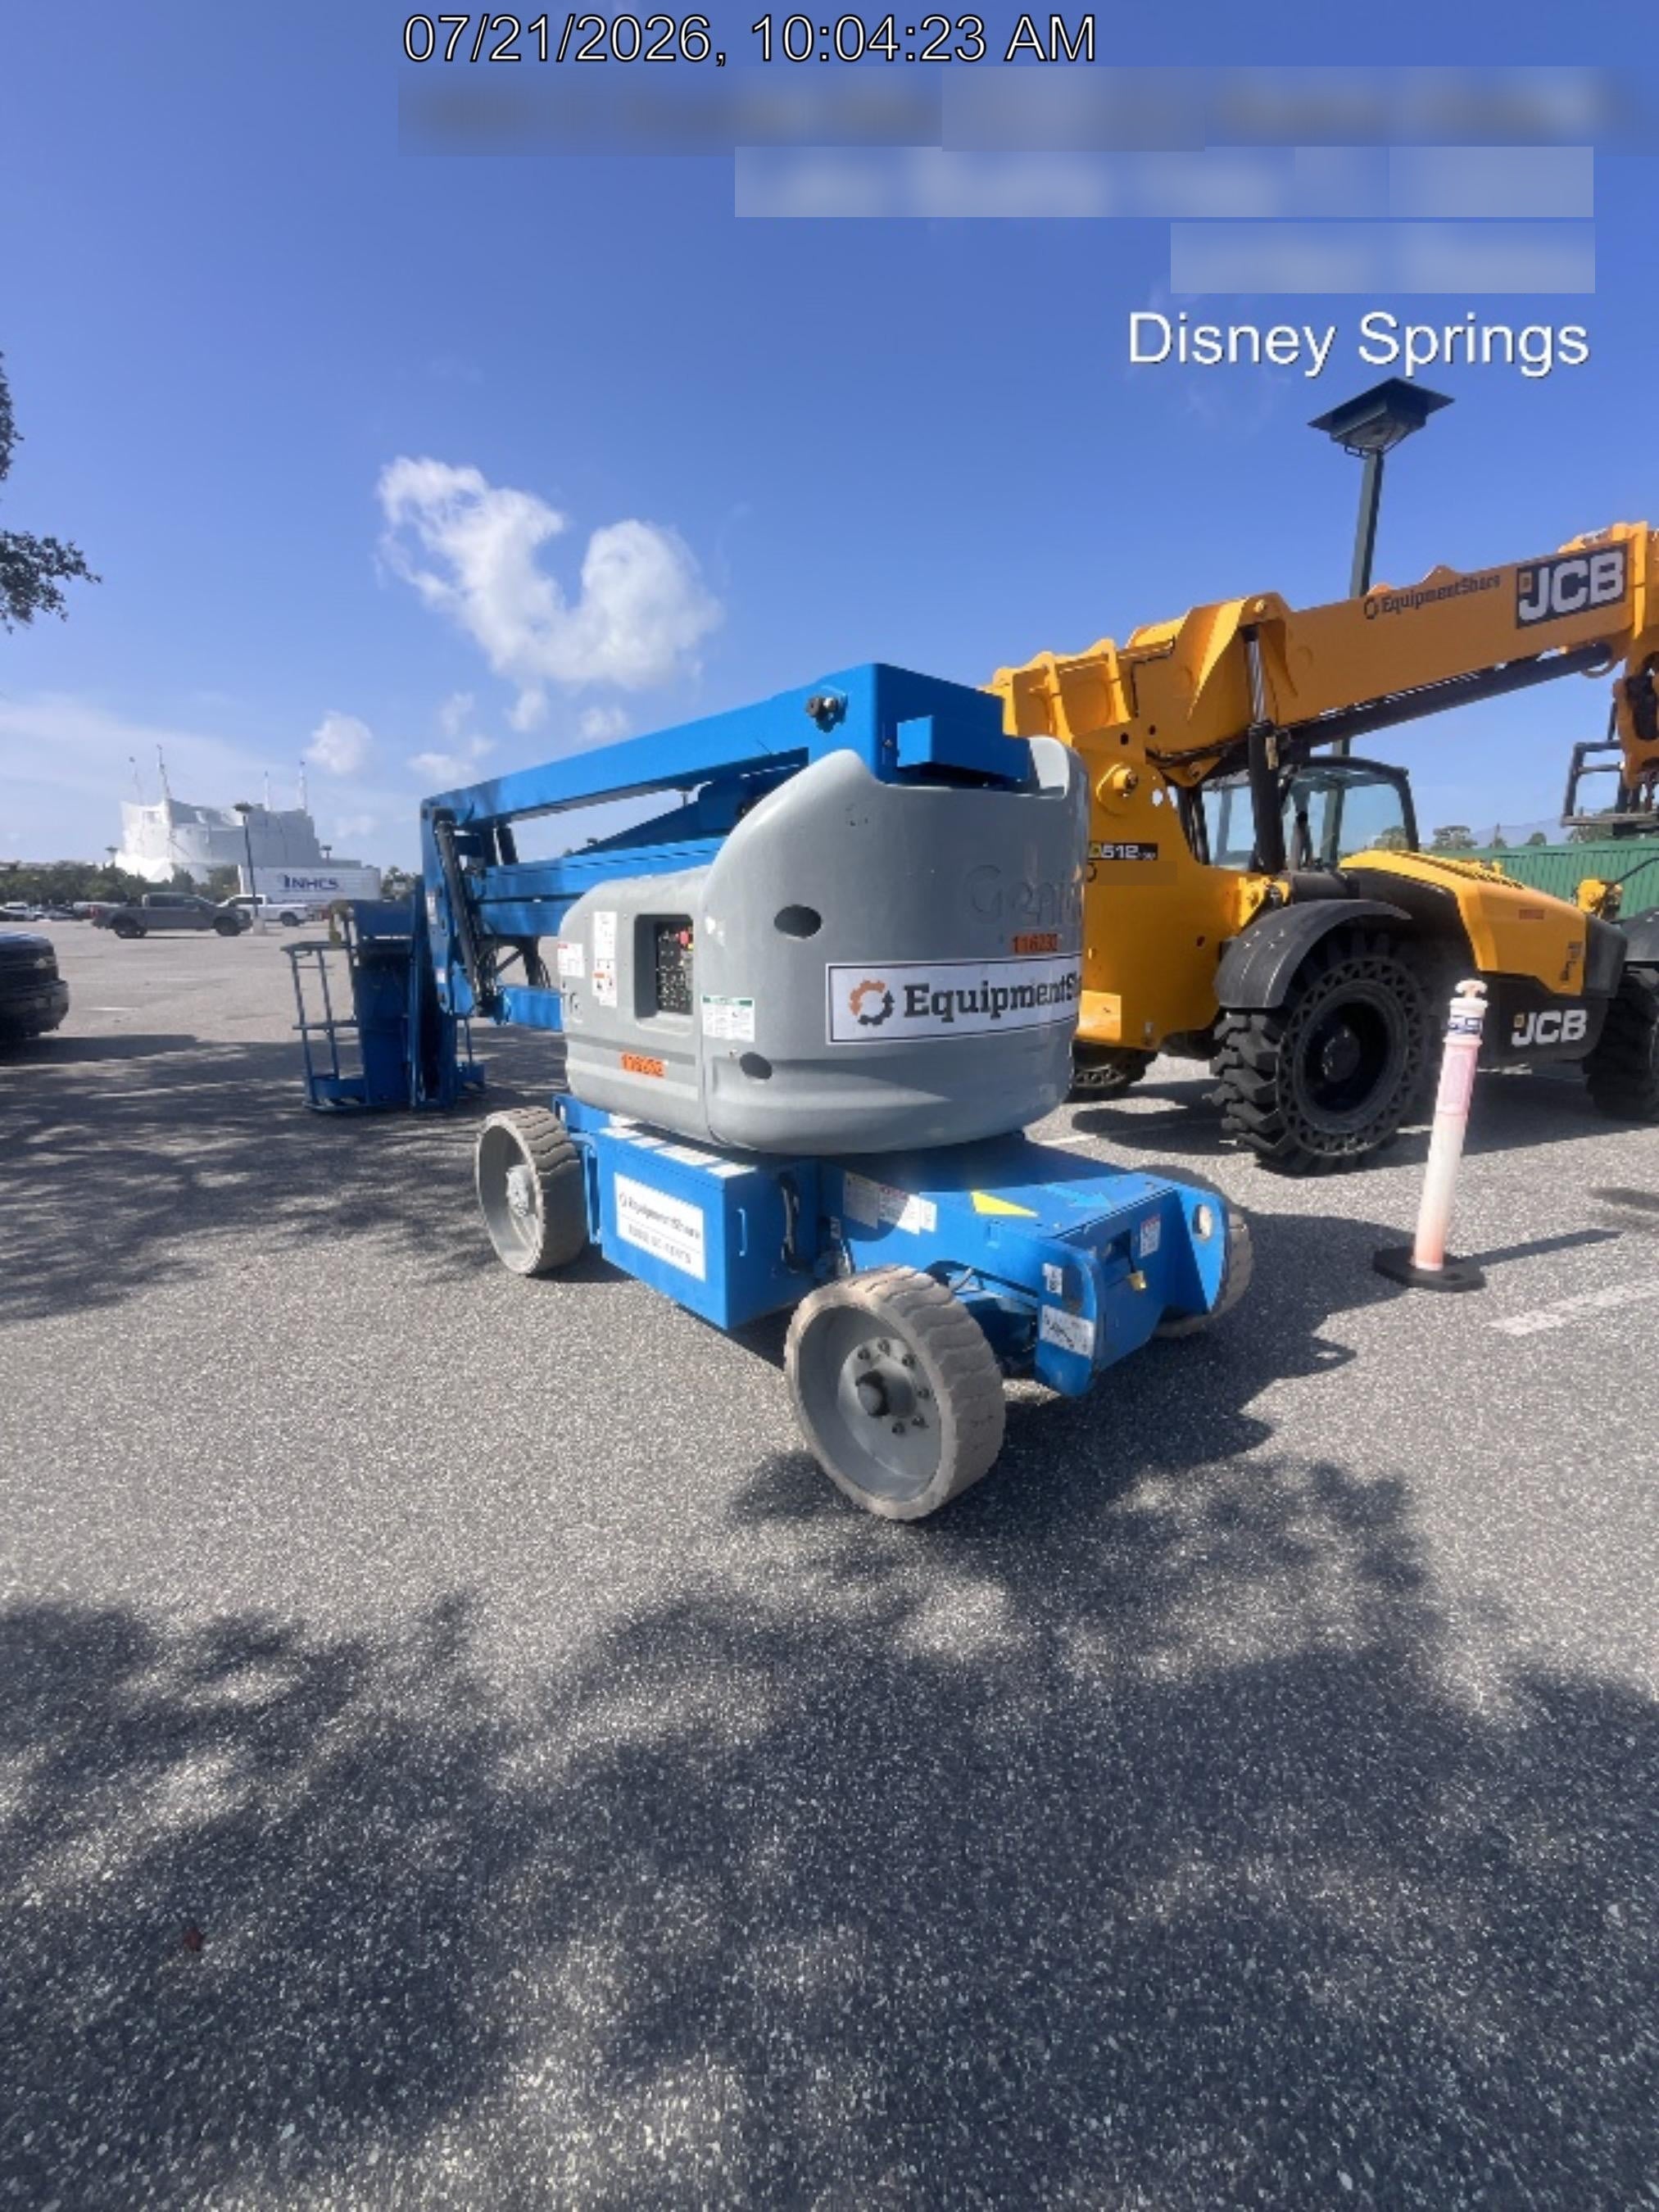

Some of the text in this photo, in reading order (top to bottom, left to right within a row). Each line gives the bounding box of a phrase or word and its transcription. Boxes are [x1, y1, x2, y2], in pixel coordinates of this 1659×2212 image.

[1381, 574, 1500, 614] EquipmentShare
[1519, 551, 1624, 621] JCB
[1512, 1009, 1587, 1047] JCB
